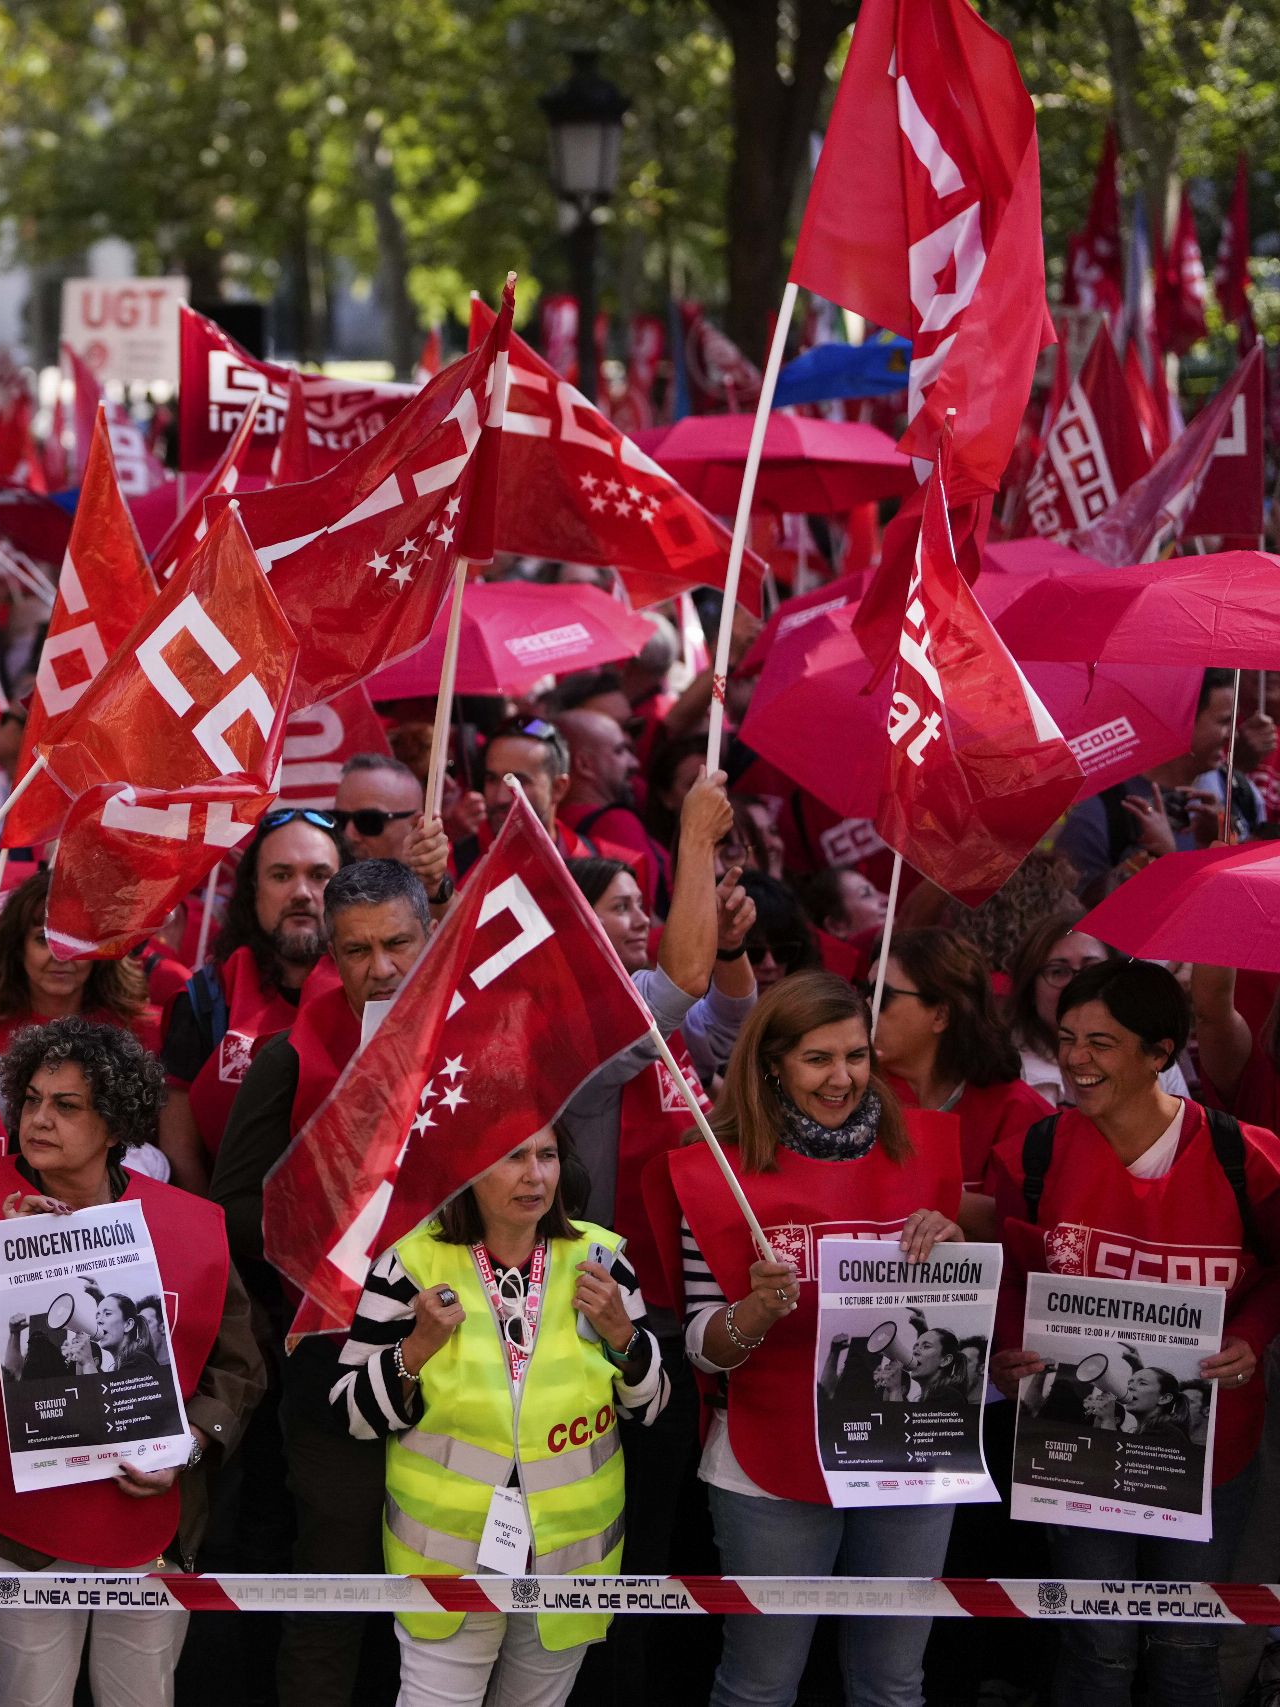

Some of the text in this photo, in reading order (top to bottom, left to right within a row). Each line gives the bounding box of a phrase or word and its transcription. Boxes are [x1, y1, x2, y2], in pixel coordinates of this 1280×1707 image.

[81, 288, 167, 330] UGT
[3, 1219, 136, 1262] CONCENTRACIÓN
[14, 1271, 44, 1285] OCTUBRE
[45, 1267, 63, 1279] 12:00
[64, 1266, 69, 1275] H
[75, 1258, 108, 1272] MINISTERIO
[109, 1257, 117, 1267] DE
[117, 1252, 140, 1265] SANIDAD
[839, 1258, 982, 1284] CONCENTRACIÓN
[844, 1296, 873, 1305] OCTUBRE
[876, 1296, 893, 1304] 12:00
[894, 1296, 899, 1304] H
[906, 1294, 941, 1303] MINISTERIO
[941, 1294, 950, 1302] DE
[952, 1293, 978, 1302] SANIDAD
[1047, 1292, 1202, 1329] CONCENTRACIÓN
[1051, 1324, 1081, 1335] OCTUBRE
[1084, 1327, 1103, 1337] 12:00
[1104, 1329, 1110, 1338] H
[1117, 1330, 1157, 1342] MINISTERIO
[1158, 1334, 1167, 1343] DE
[1168, 1335, 1199, 1346] SANIDAD
[34, 1398, 67, 1410] ESTATUTO
[40, 1408, 63, 1419] MARCO
[843, 1421, 872, 1431] ESTATUTO
[847, 1431, 869, 1441] MARCO
[1045, 1440, 1078, 1452] ESTATUTO
[1048, 1451, 1072, 1461] MARCO
[1099, 1505, 1114, 1513] UGT
[494, 1519, 523, 1535] SERVICIO
[502, 1531, 511, 1539] DE
[496, 1536, 516, 1549] ORDEN
[23, 1589, 170, 1606] LINEA DE POLICIA
[543, 1593, 690, 1610] LINEA DE POLICIA
[1070, 1599, 1225, 1618] LINEA DE POLICIA
